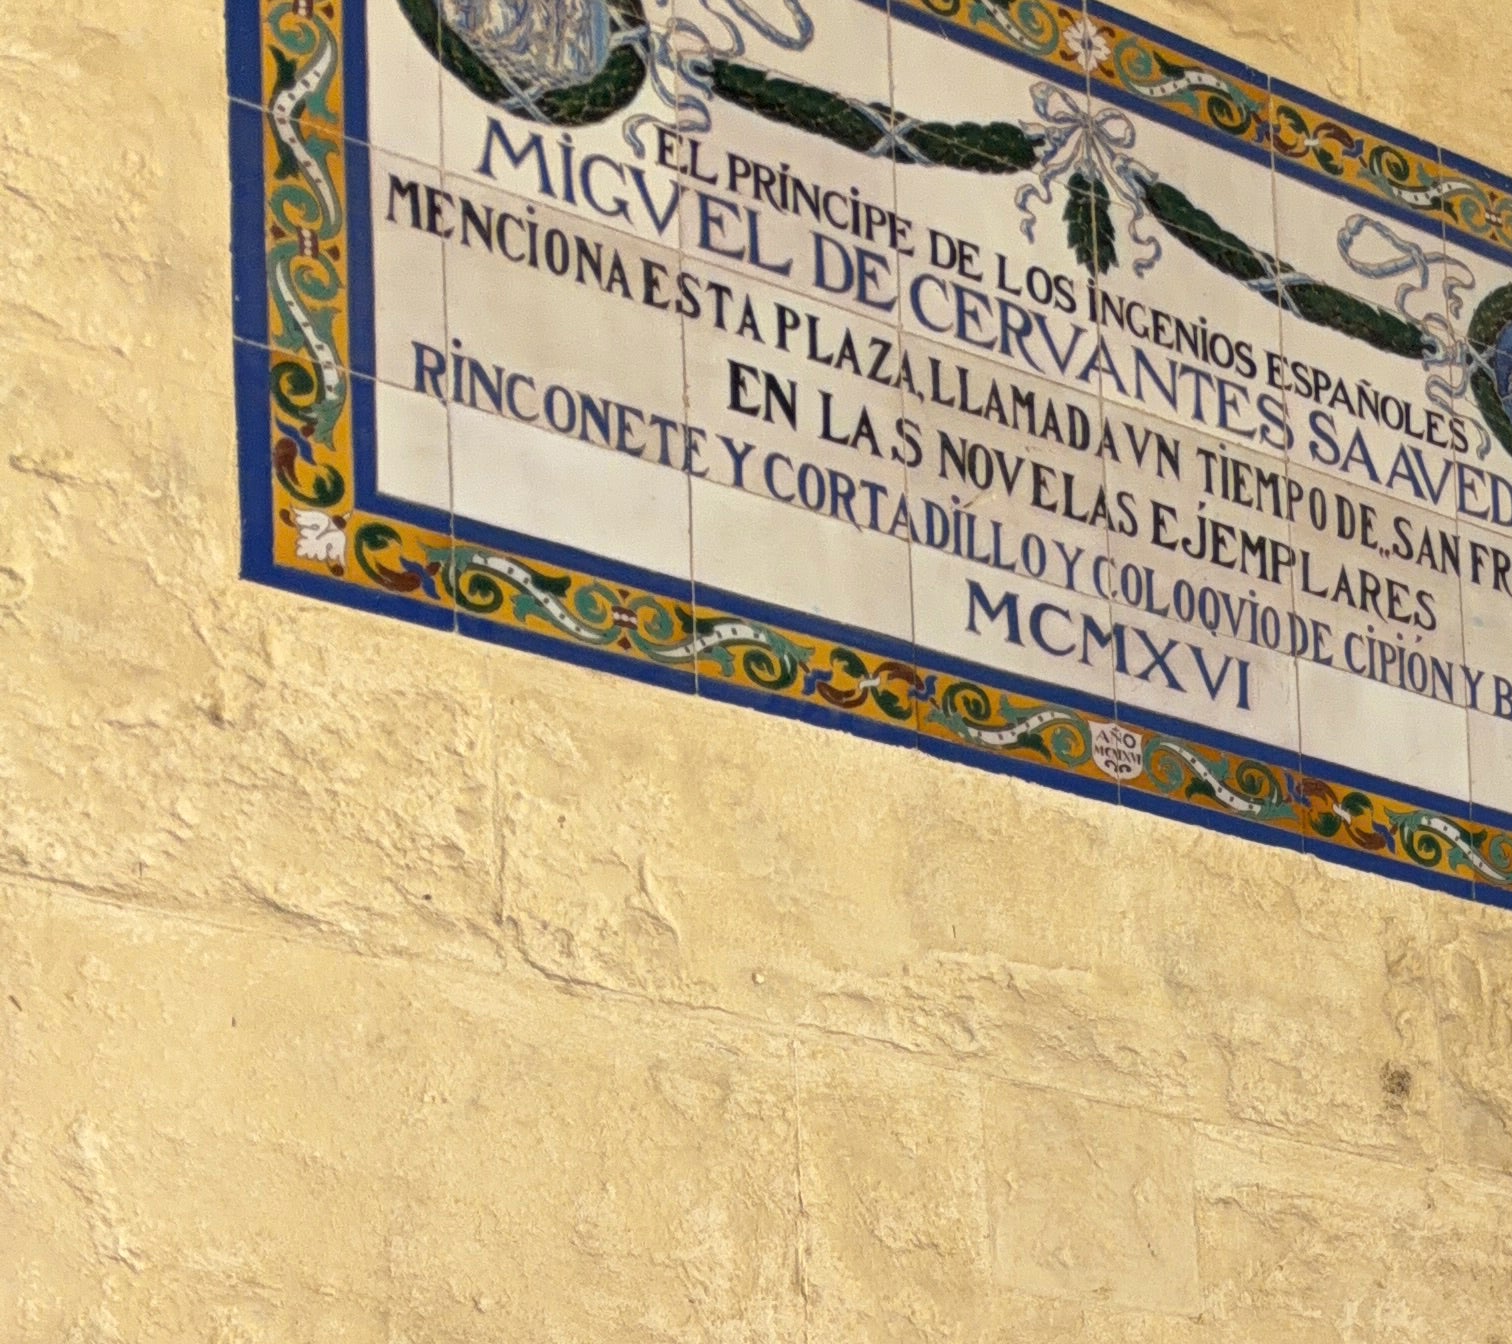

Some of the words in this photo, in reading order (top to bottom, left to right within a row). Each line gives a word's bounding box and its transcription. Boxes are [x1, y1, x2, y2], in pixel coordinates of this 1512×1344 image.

[386, 173, 634, 300] MENCIONA
[640, 257, 765, 344] ESTA
[928, 356, 1121, 463] LLAMADA
[1122, 422, 1181, 481] VN
[1196, 443, 1327, 531] TIEMPO
[1335, 494, 1379, 550] DE
[474, 116, 793, 277] MIGVEL
[811, 230, 898, 313] DE
[910, 273, 1294, 450] CERVANTES
[655, 124, 718, 185] EL
[726, 151, 915, 257] PRINCIPE
[927, 228, 983, 282] DE
[995, 252, 1077, 313] LOS
[1085, 278, 1257, 380] INGENIOS
[1263, 349, 1469, 453] ESPAÑOLES
[411, 338, 709, 477] RINCONETE
[715, 433, 756, 489] Y
[764, 451, 1046, 578] CORTADILLO
[1052, 540, 1085, 590] Y
[1093, 555, 1280, 650] COLOQVIO
[1287, 611, 1333, 666] DE
[1460, 664, 1485, 710] Y
[727, 359, 797, 432] EN
[818, 390, 923, 468] LAS
[937, 430, 1138, 537] NOVELAS
[1150, 500, 1436, 631] EJEMPLARES
[966, 579, 1251, 711] MCMXVI
[1096, 727, 1136, 749] AÑO
